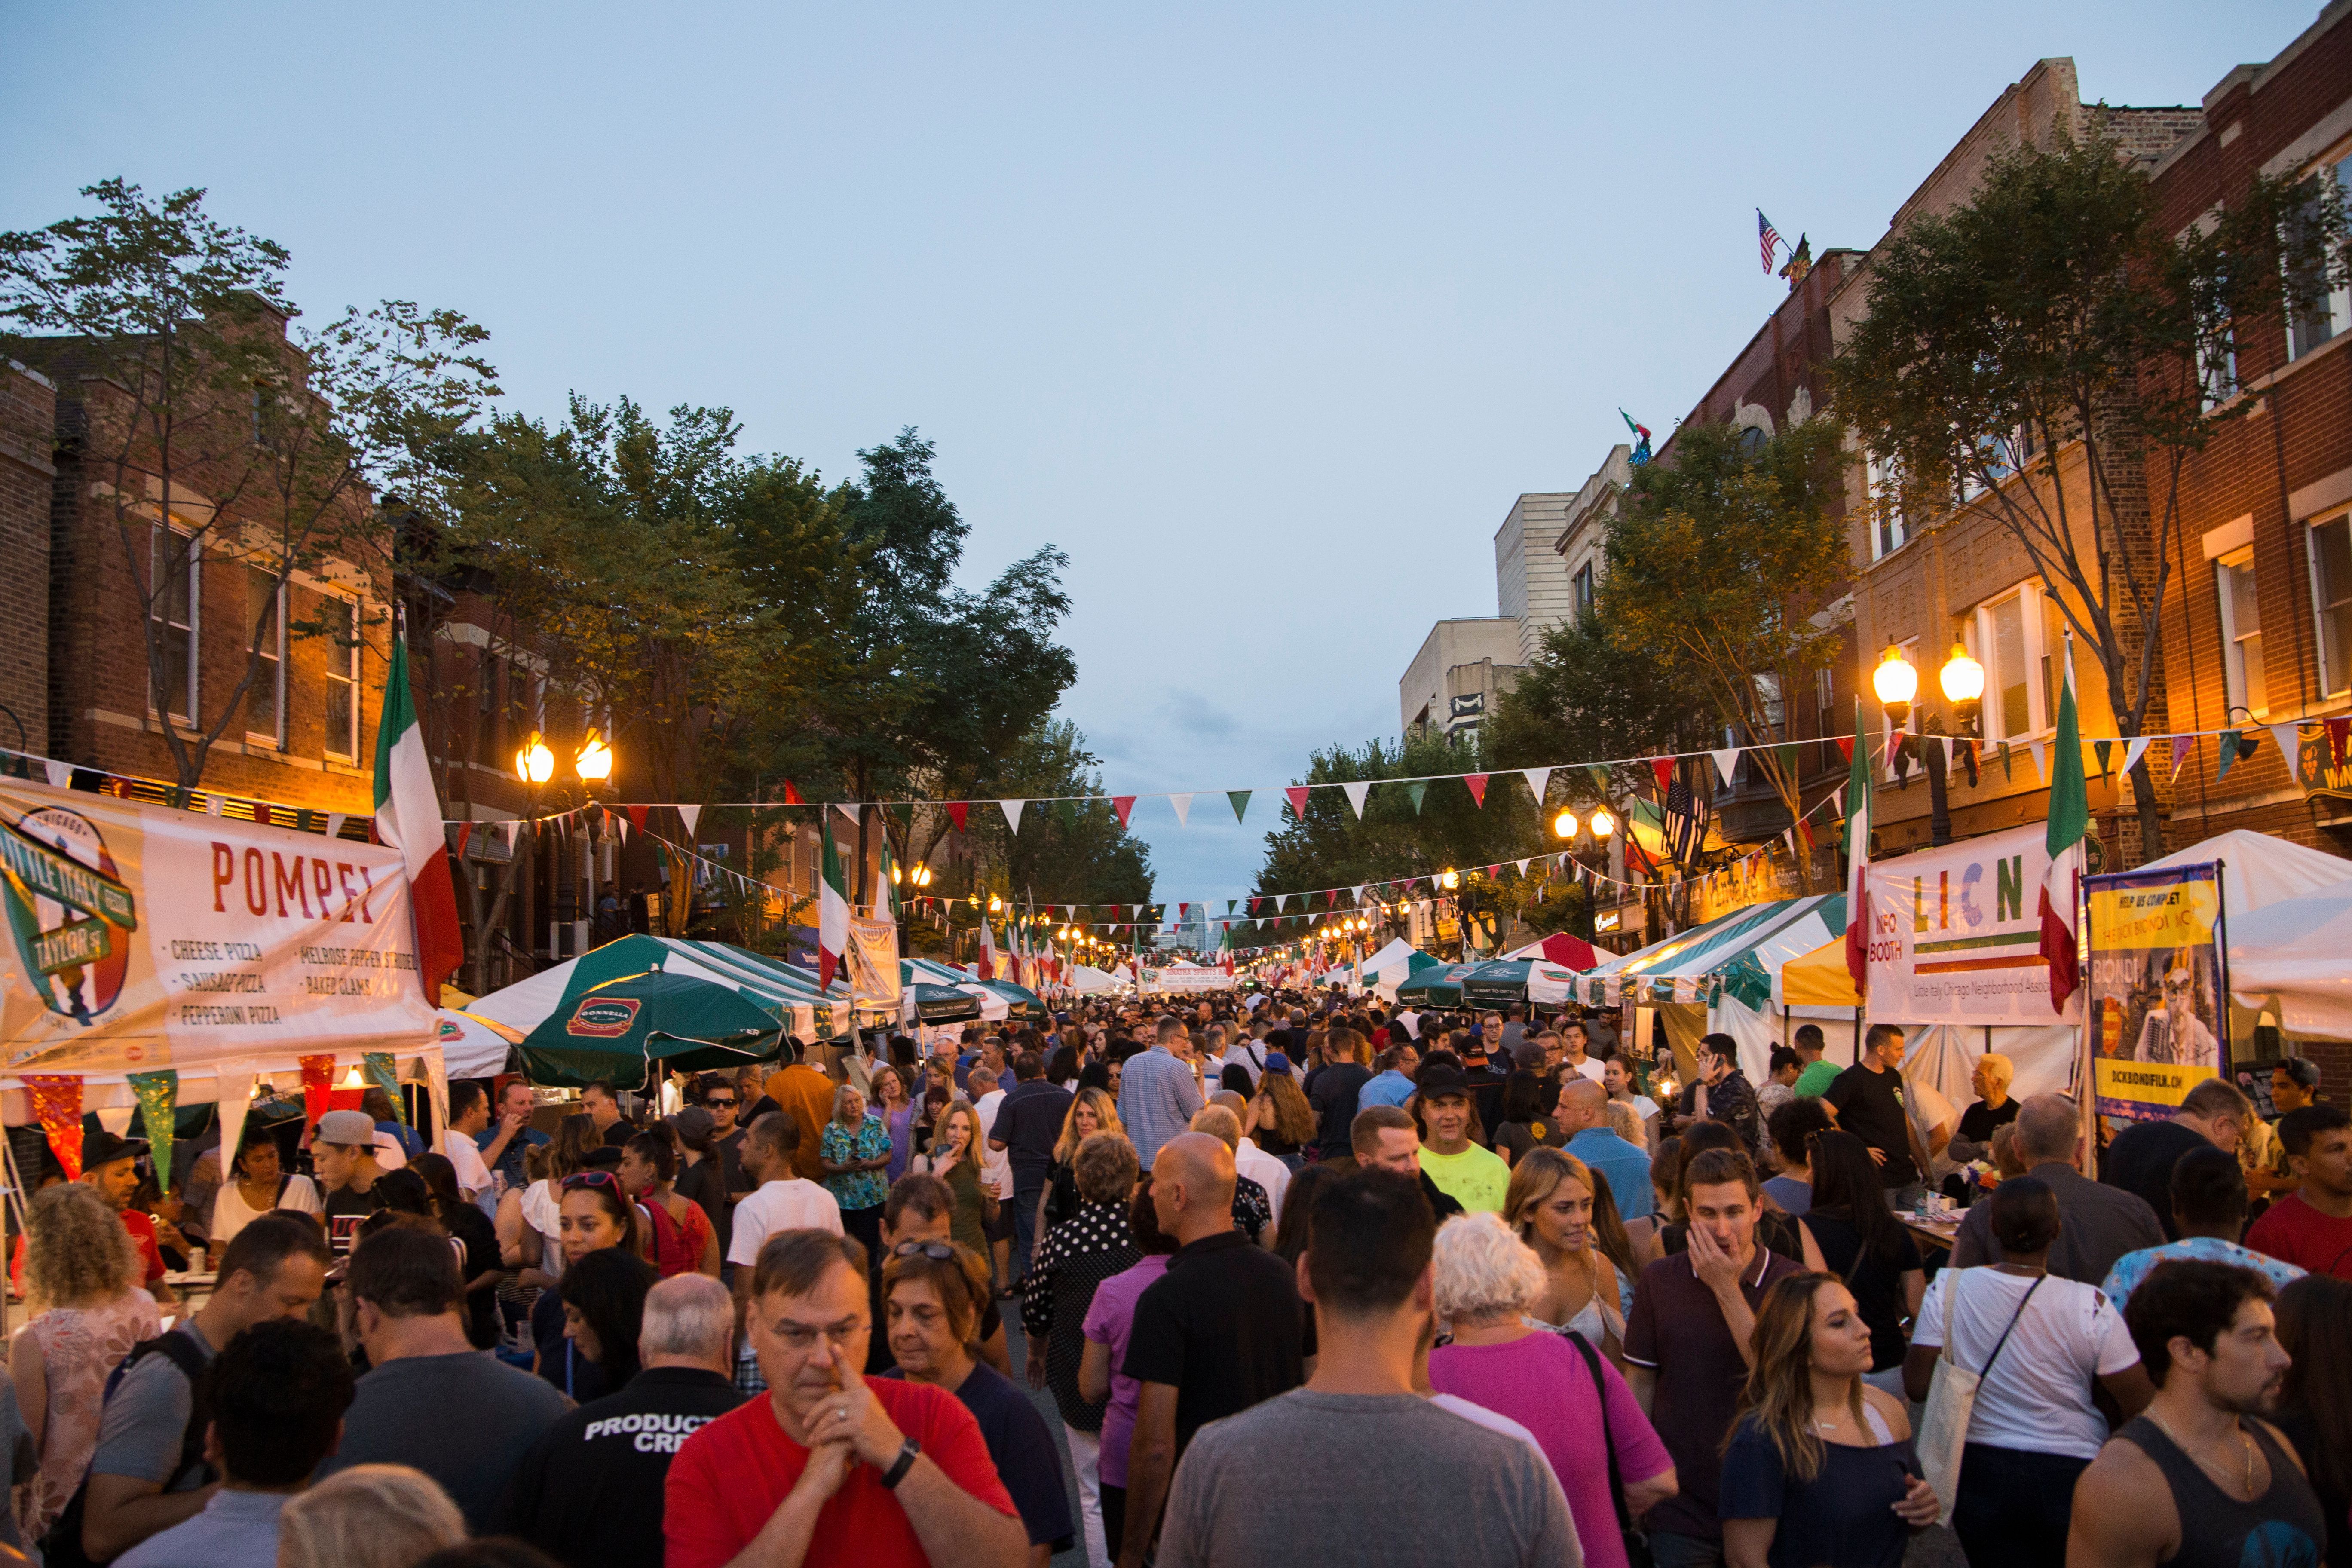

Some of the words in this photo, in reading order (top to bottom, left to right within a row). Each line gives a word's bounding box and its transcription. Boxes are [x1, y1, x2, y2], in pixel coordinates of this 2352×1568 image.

[57, 862, 100, 911] ITALY
[211, 841, 374, 924] POMPEI
[34, 928, 89, 970] TAYLOR
[171, 940, 224, 961] CHEESE
[224, 943, 263, 962] PIZZA
[301, 946, 347, 965] MELROSE
[350, 949, 380, 968] PEPPER
[1870, 940, 1902, 962] BOOTH
[2094, 956, 2139, 984] BIONDI
[180, 972, 237, 993] SAUSAGE
[236, 974, 266, 993] PIZZA
[306, 976, 336, 995] BAKED
[338, 978, 372, 996] CLAMS
[1914, 983, 1928, 997] Little
[1944, 982, 1969, 1000] Chicago
[1972, 979, 2023, 999] Neighborhood
[181, 1005, 246, 1025] PEPPERONI
[248, 1006, 282, 1025] PIZZA
[581, 1011, 629, 1019] GONNELLA
